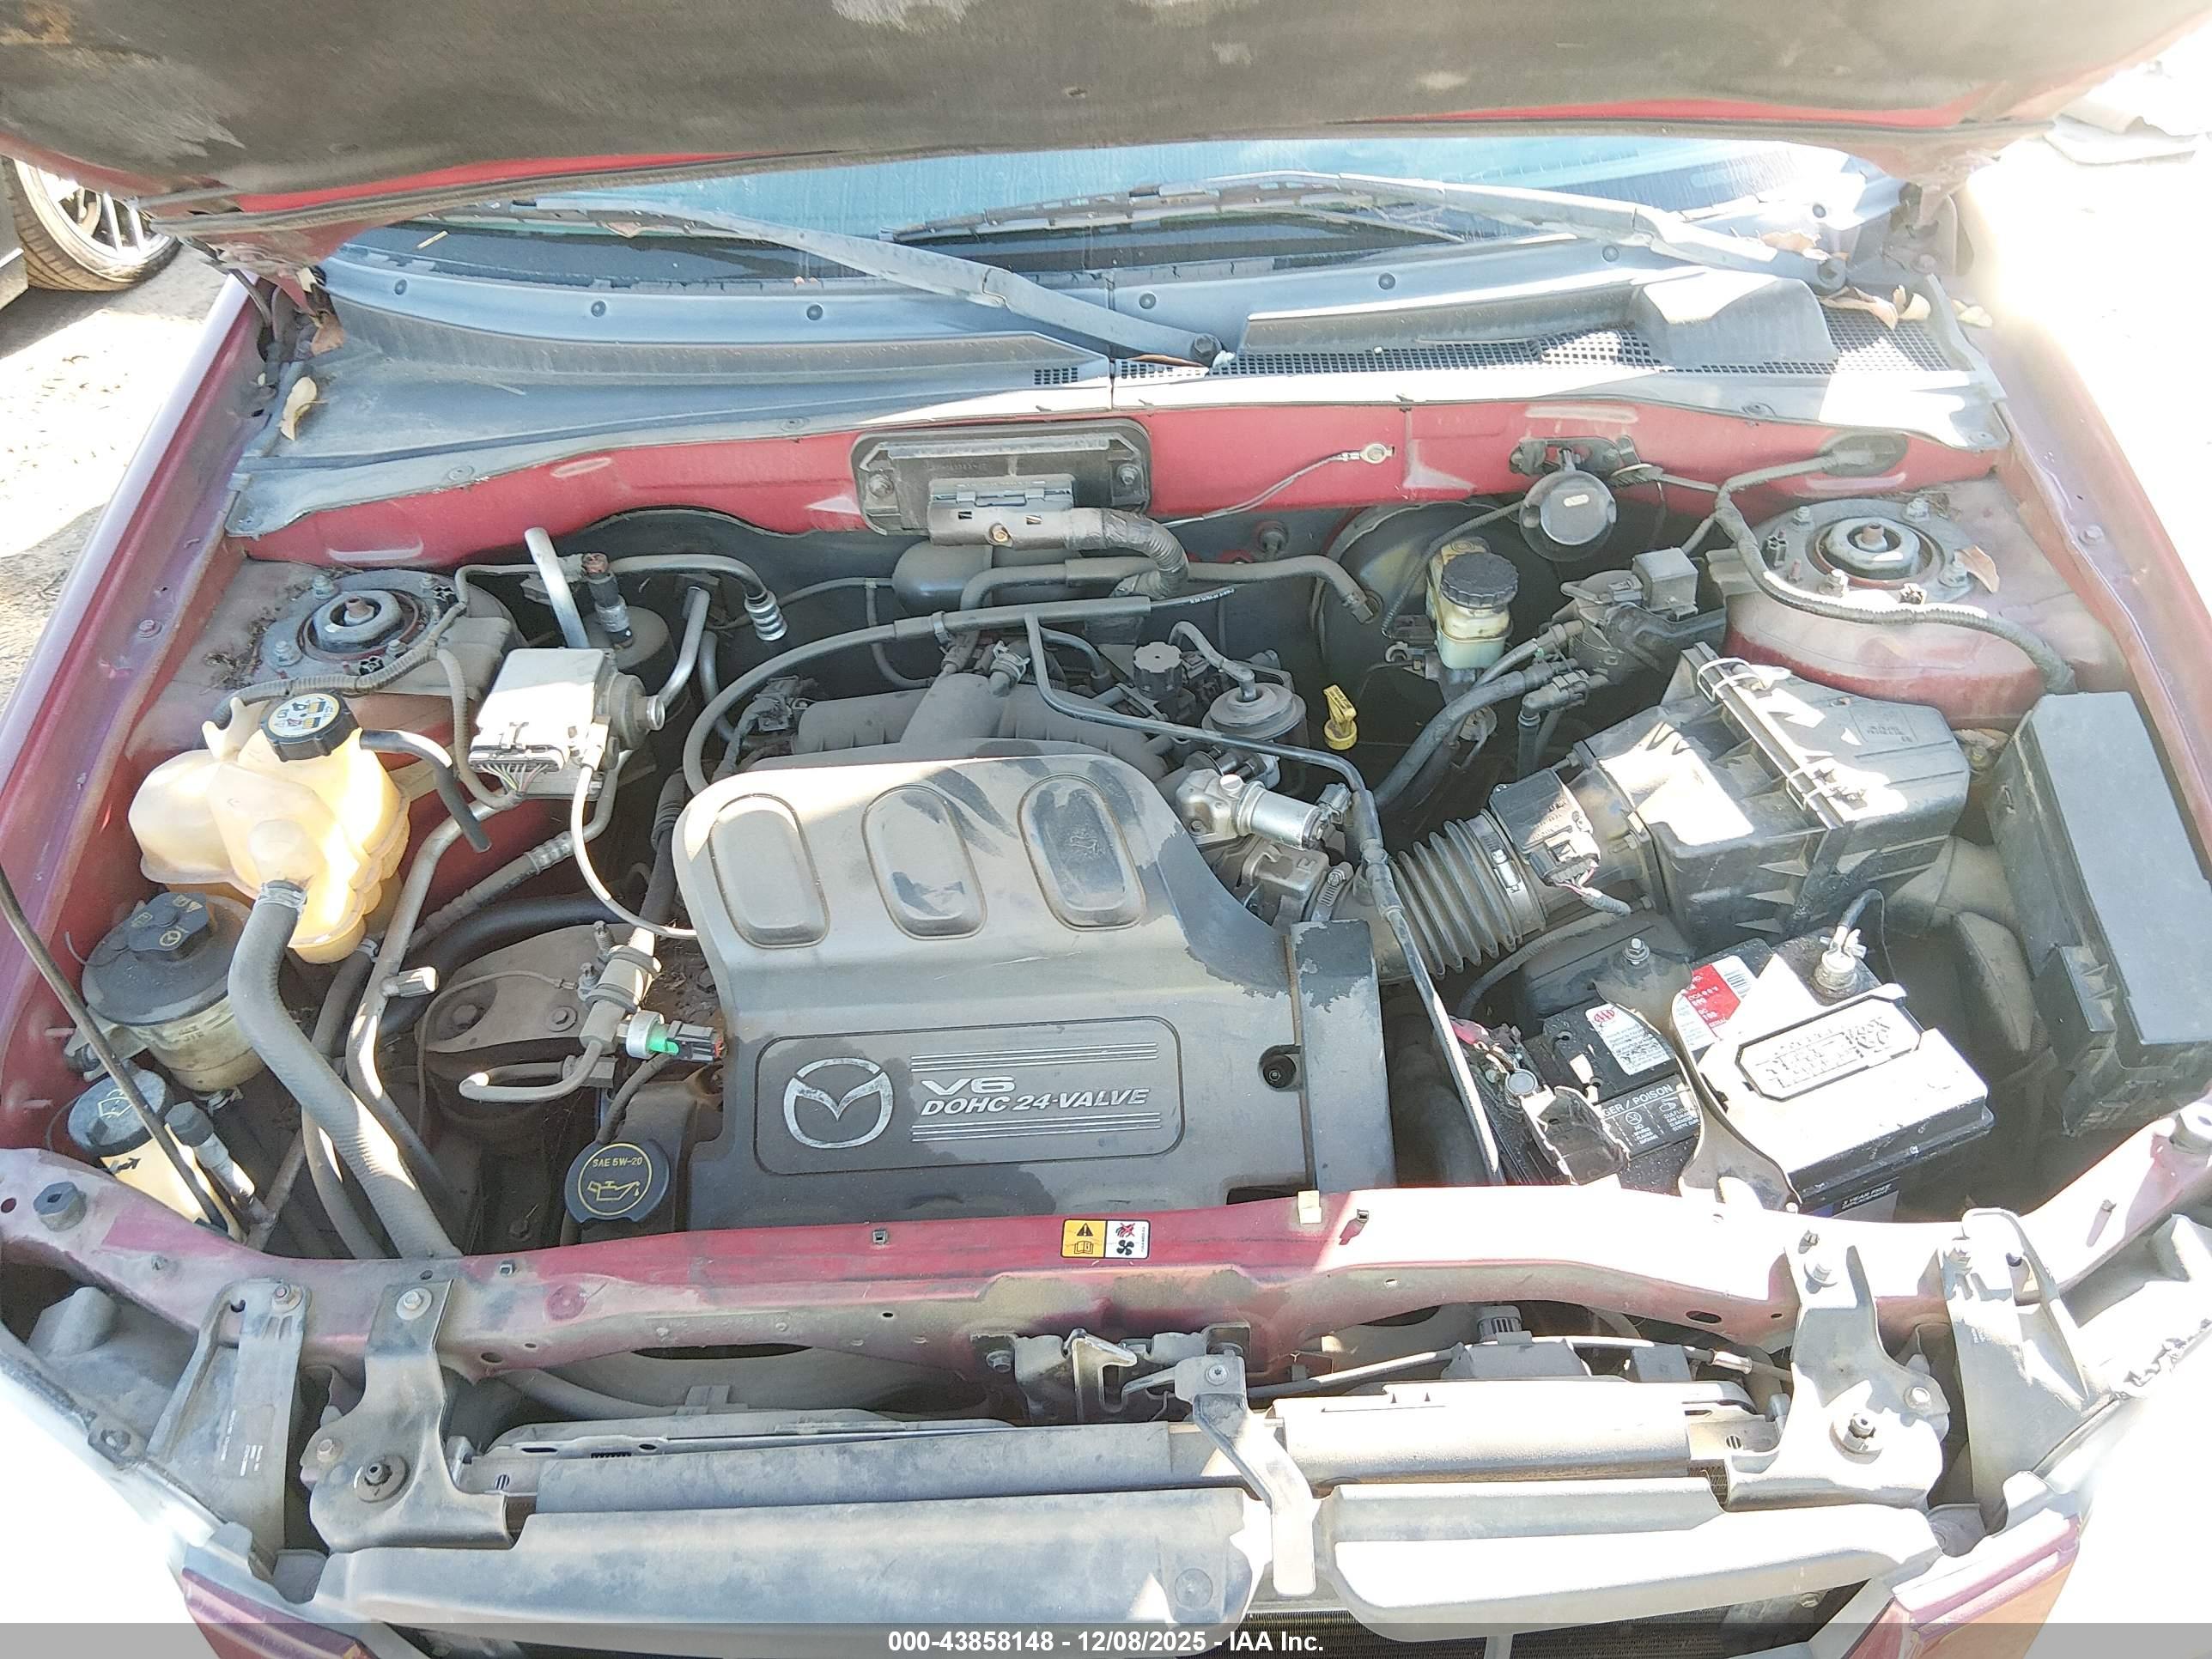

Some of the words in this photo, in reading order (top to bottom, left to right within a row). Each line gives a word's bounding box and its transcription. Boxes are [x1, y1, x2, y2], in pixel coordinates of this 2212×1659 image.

[921, 1075, 1016, 1097] V6
[1632, 1084, 1674, 1105] POISON
[920, 1096, 1012, 1116] DOHC
[1012, 1088, 1151, 1110] 24-VALVE
[592, 1158, 611, 1168] SAE
[612, 1157, 643, 1166] 5W-20
